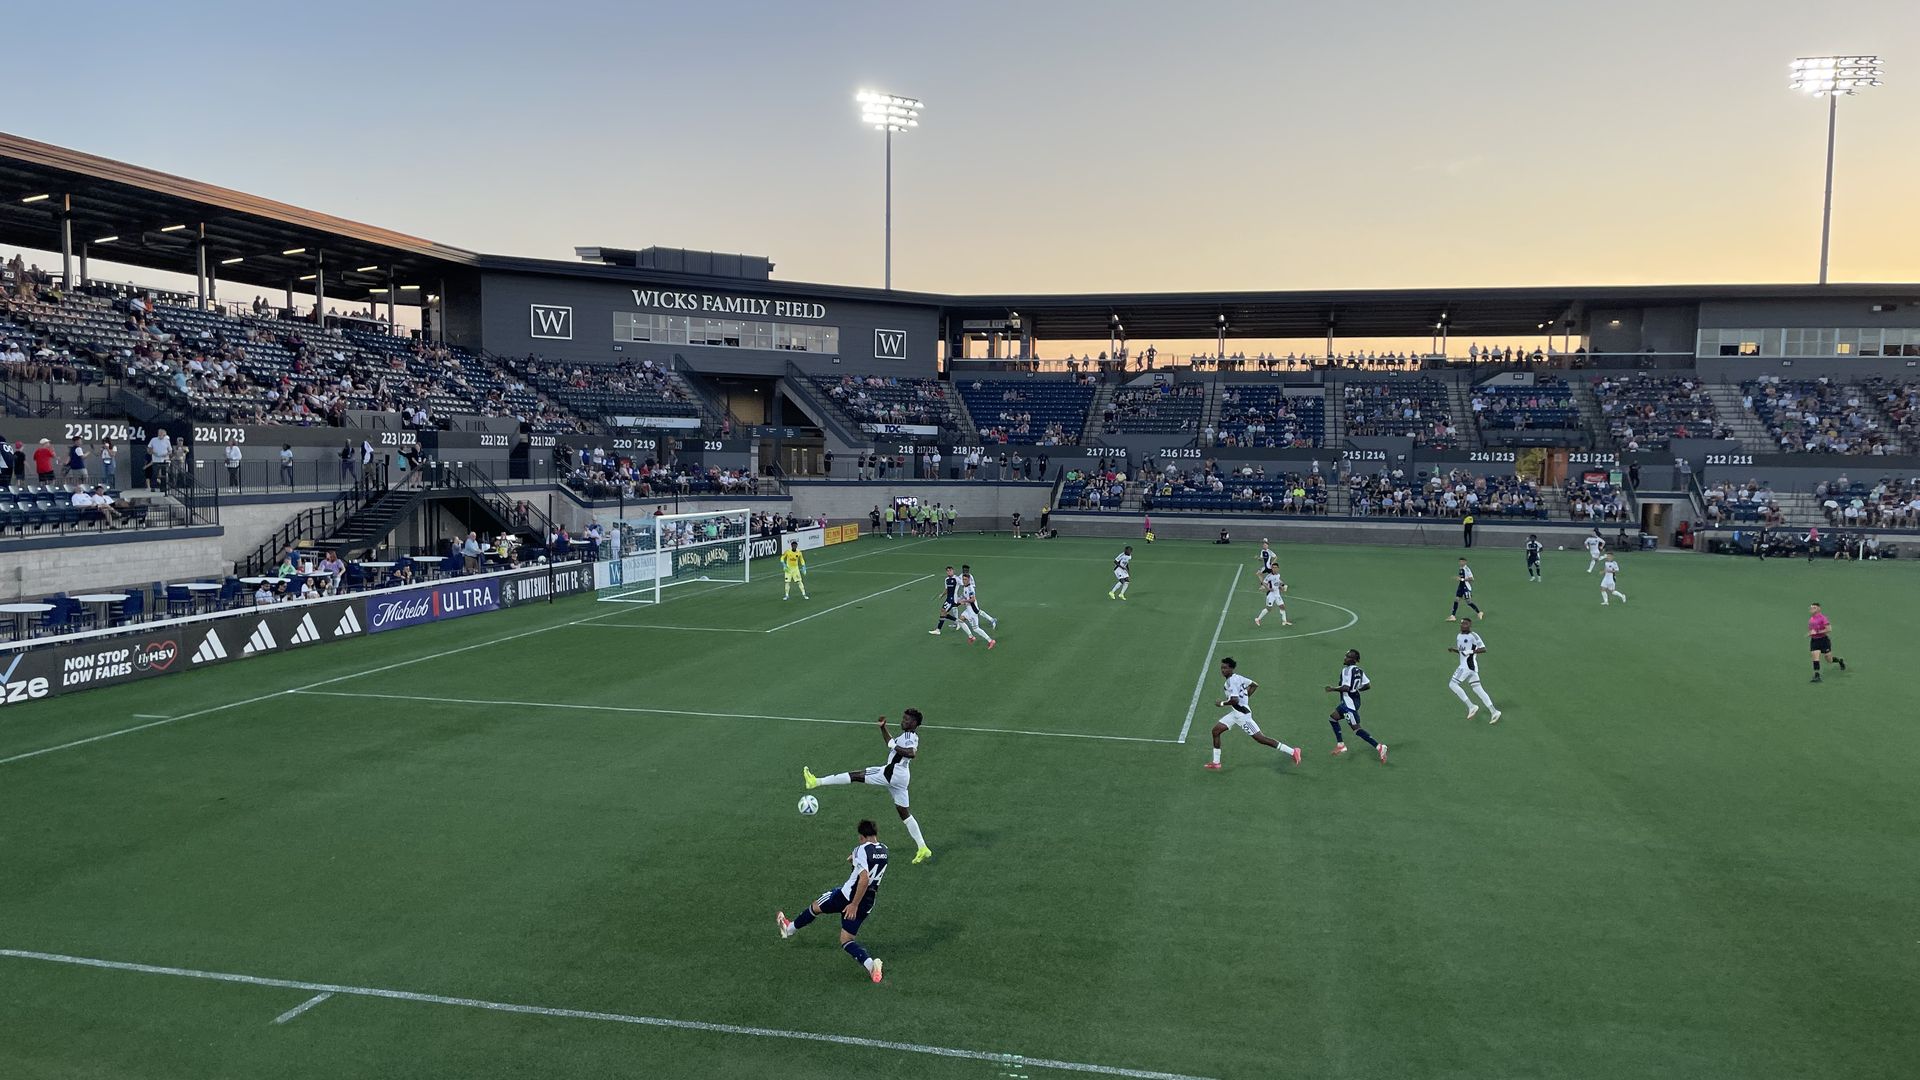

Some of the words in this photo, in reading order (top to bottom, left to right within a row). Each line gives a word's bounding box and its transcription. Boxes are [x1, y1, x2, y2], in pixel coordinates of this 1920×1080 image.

[632, 289, 698, 311] WICKS
[702, 294, 770, 316] FAMILY
[774, 301, 826, 319] FIELD
[535, 309, 567, 334] W
[878, 333, 903, 355] W
[704, 441, 723, 450] 219
[898, 445, 914, 454] 218
[373, 596, 430, 627] Michelob
[443, 586, 493, 612] ULTRA
[64, 655, 95, 672] NON
[97, 649, 130, 666] STOP
[62, 669, 91, 687] LOW
[95, 662, 133, 679] FARES
